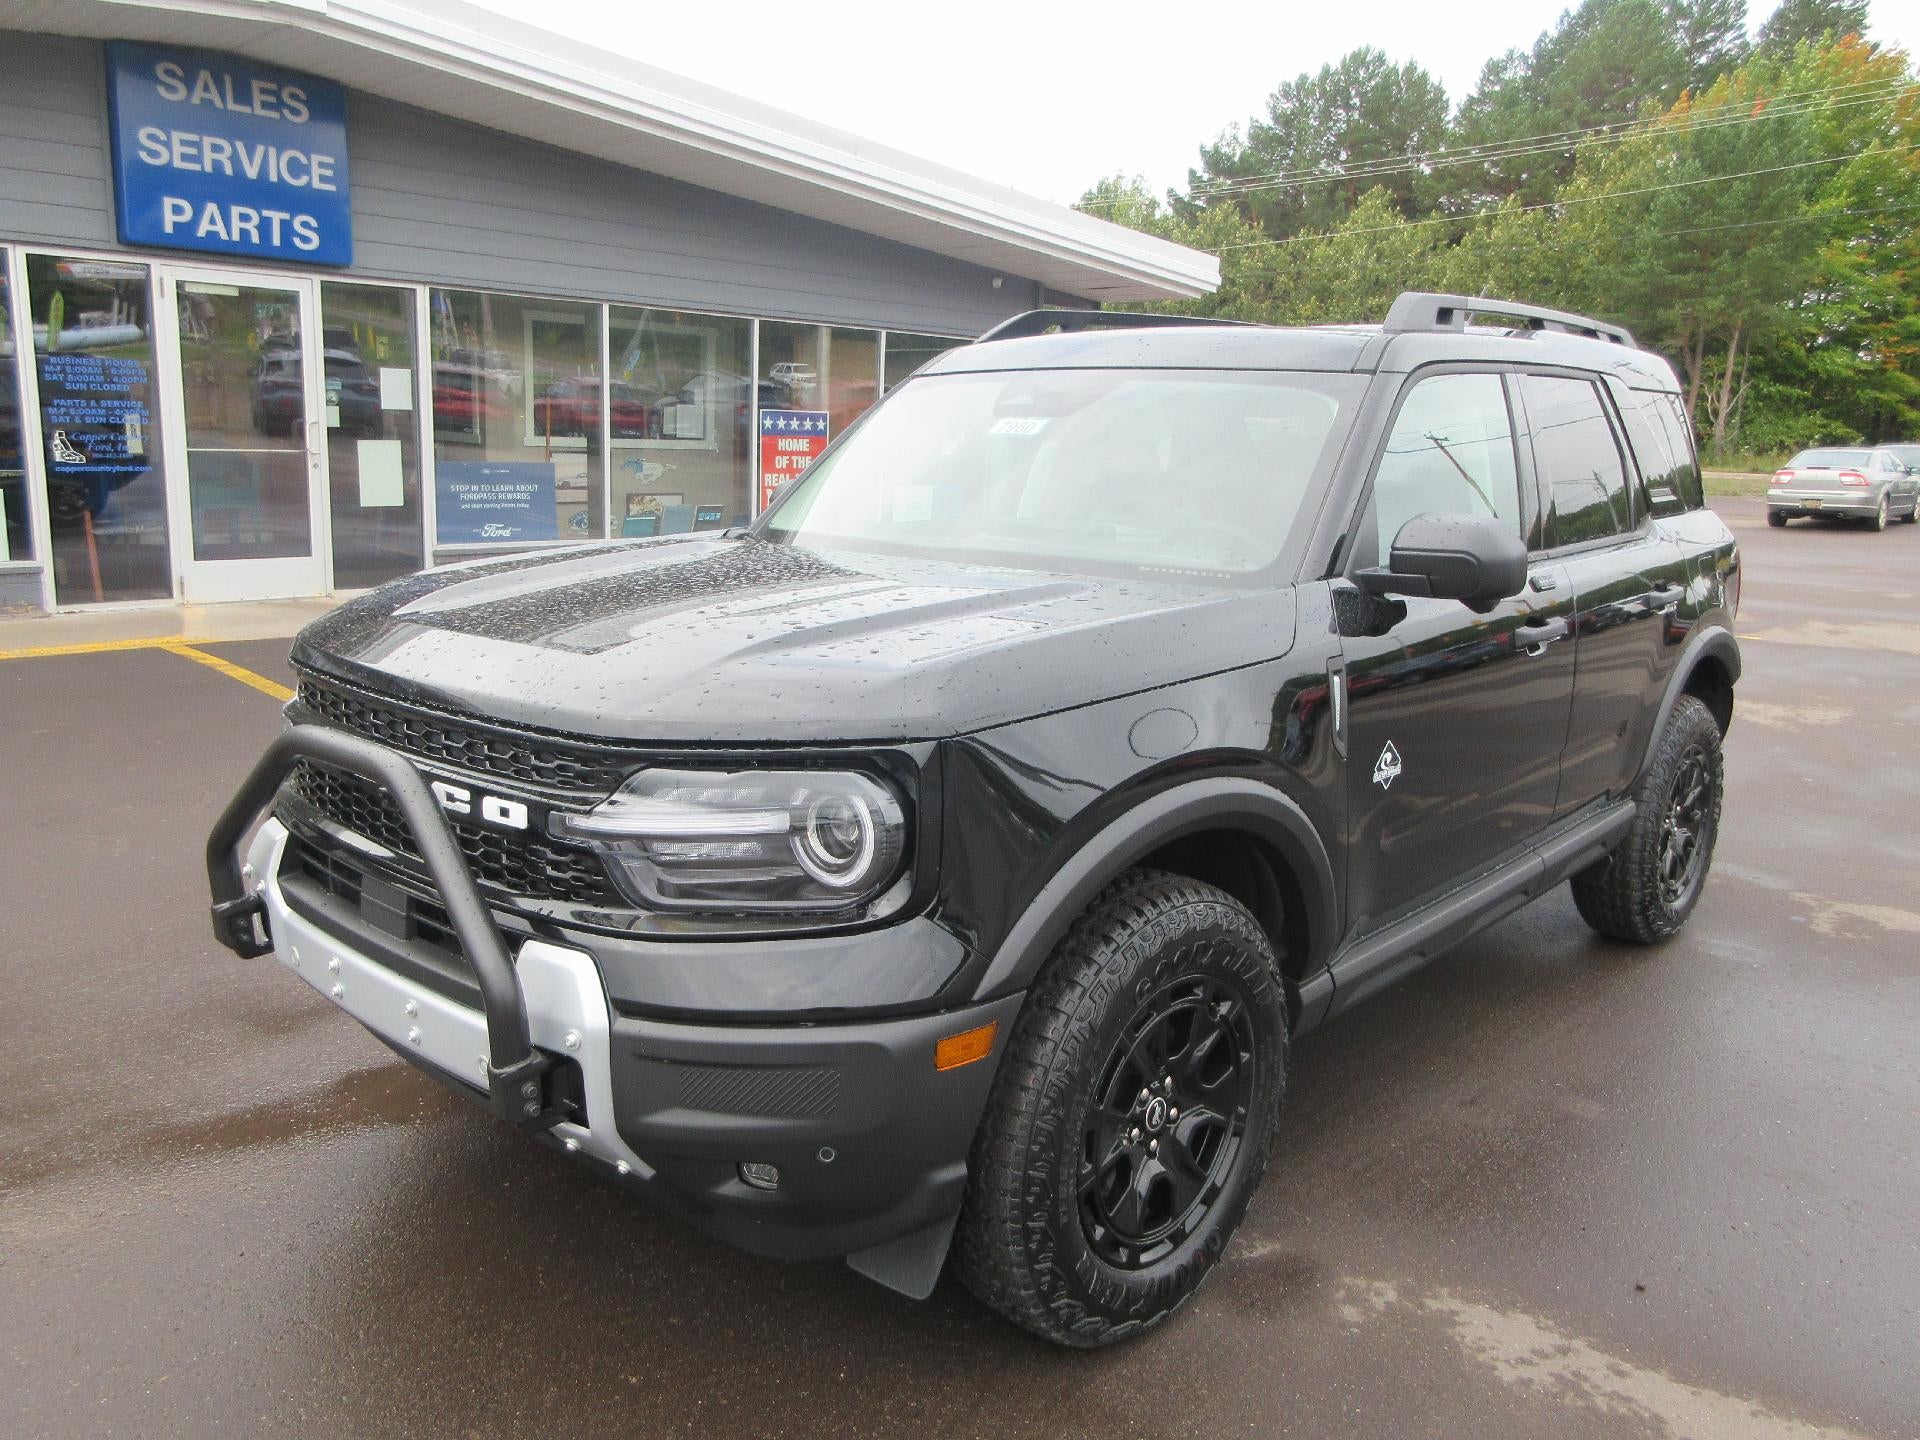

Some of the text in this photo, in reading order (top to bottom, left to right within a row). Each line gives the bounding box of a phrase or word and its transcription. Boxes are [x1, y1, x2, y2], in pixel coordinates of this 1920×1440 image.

[155, 62, 310, 123] SALES
[137, 127, 337, 192] SERVICE
[162, 196, 321, 251] PARTS
[50, 357, 141, 368] BUSINESS HOURS
[67, 374, 104, 382] 8:00AM
[53, 399, 87, 407] PARTS
[100, 400, 144, 408] SERVICE
[85, 416, 106, 424] SUN
[72, 432, 108, 442] Copper
[778, 438, 810, 452] HOME
[775, 456, 790, 469] OF
[481, 523, 513, 538] Ford
